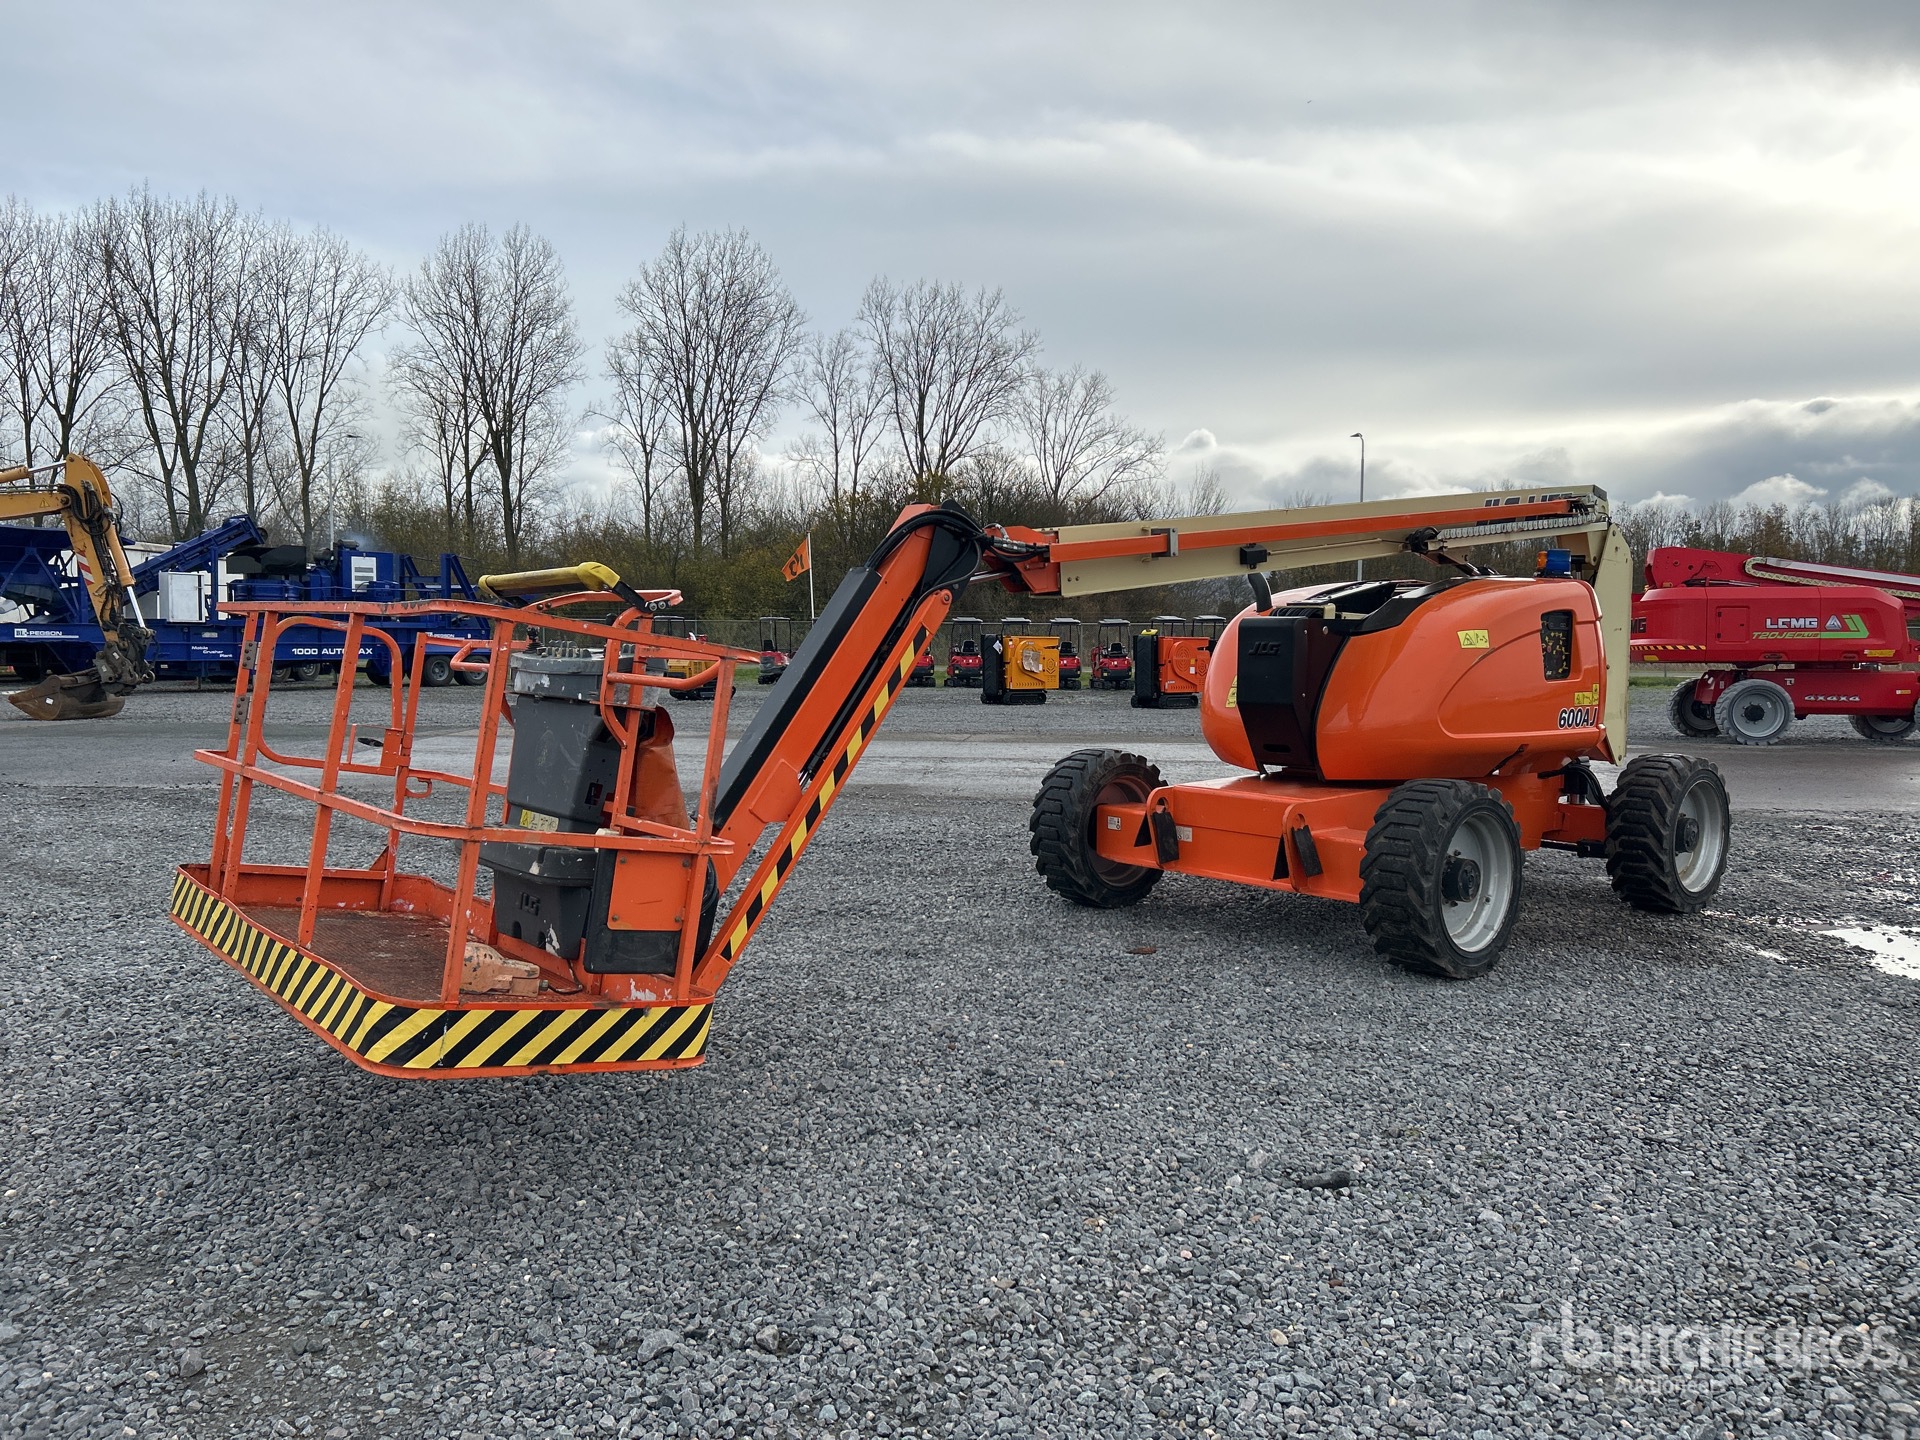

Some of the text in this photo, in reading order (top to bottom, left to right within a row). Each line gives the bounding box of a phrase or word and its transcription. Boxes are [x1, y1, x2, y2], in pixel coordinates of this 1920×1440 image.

[1765, 617, 1819, 629] LCMG
[1248, 642, 1281, 656] JLG
[1557, 706, 1598, 730] 600AJ
